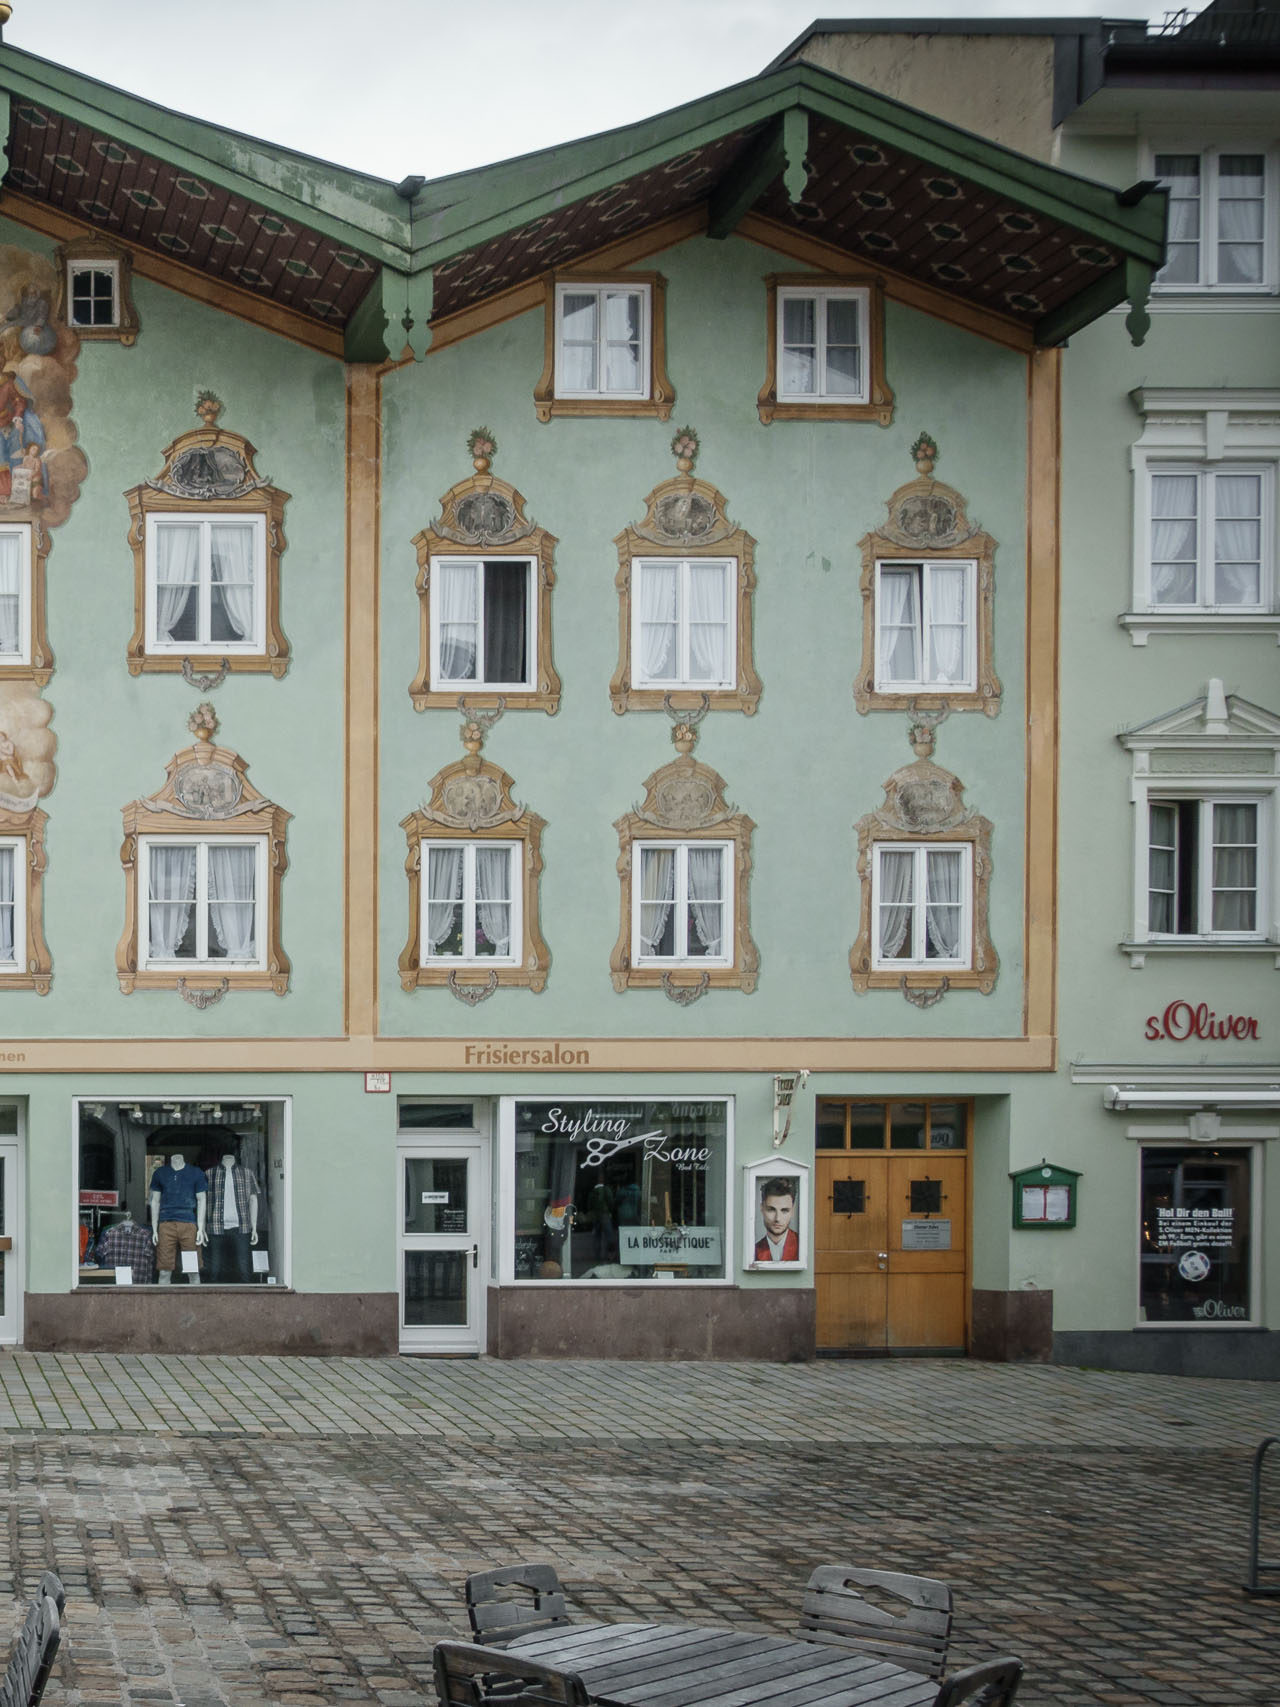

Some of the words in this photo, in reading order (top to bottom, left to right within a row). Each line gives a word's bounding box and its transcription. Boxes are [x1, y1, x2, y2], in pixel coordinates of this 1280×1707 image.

[1144, 999, 1261, 1041] s.Oliver
[464, 1043, 590, 1065] Frisiersalon
[541, 1108, 631, 1141] Styling
[643, 1136, 713, 1162] Zone
[1176, 1208, 1190, 1217] Dir
[1192, 1208, 1209, 1217] den
[627, 1237, 639, 1249] LA
